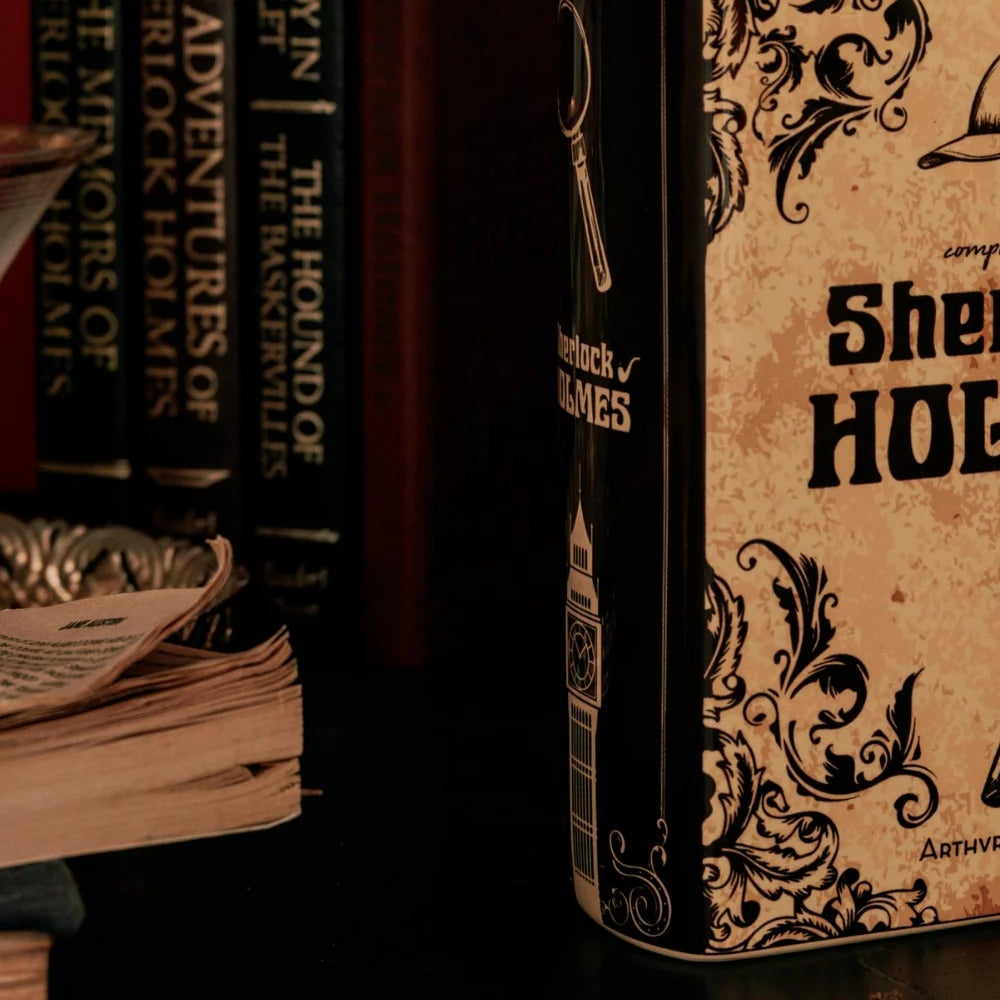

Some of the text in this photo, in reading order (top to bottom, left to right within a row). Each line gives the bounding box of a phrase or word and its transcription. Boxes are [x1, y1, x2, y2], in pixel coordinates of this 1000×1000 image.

[290, 36, 320, 81] IN
[78, 67, 118, 292] MEMOIRS
[182, 5, 228, 357] ADVENTURES
[79, 305, 119, 371] OF
[144, 210, 179, 419] HOLMES
[184, 367, 219, 422] OF
[260, 134, 288, 479] THE BASKERVILLES
[291, 160, 324, 466] THE HOUND OF
